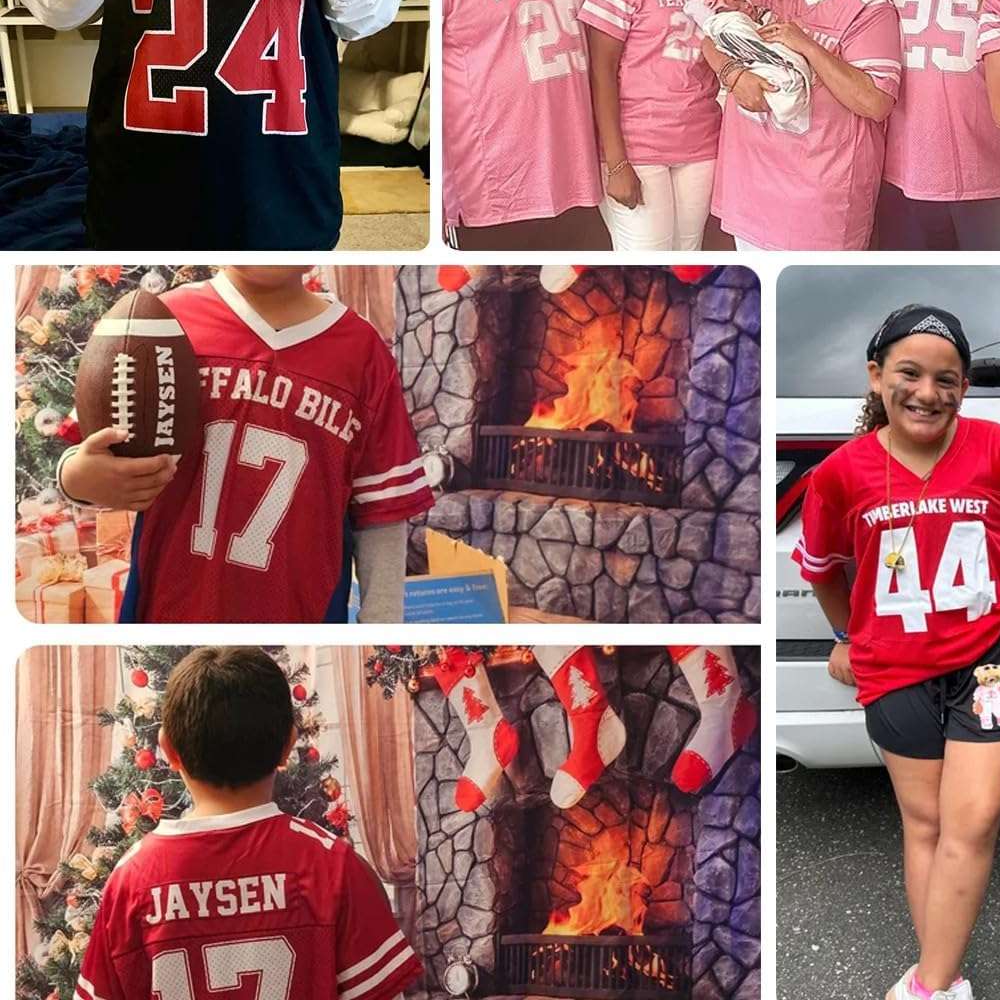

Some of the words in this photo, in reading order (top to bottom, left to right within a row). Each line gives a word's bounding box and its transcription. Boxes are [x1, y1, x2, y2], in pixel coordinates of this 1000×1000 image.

[155, 345, 176, 448] JAYSEN
[190, 419, 309, 573] 17
[862, 499, 947, 528] TIMBERLAKE
[949, 498, 989, 515] WEST
[874, 520, 998, 634] 44
[145, 873, 287, 926] JAYSEN
[151, 935, 297, 1000] 17
